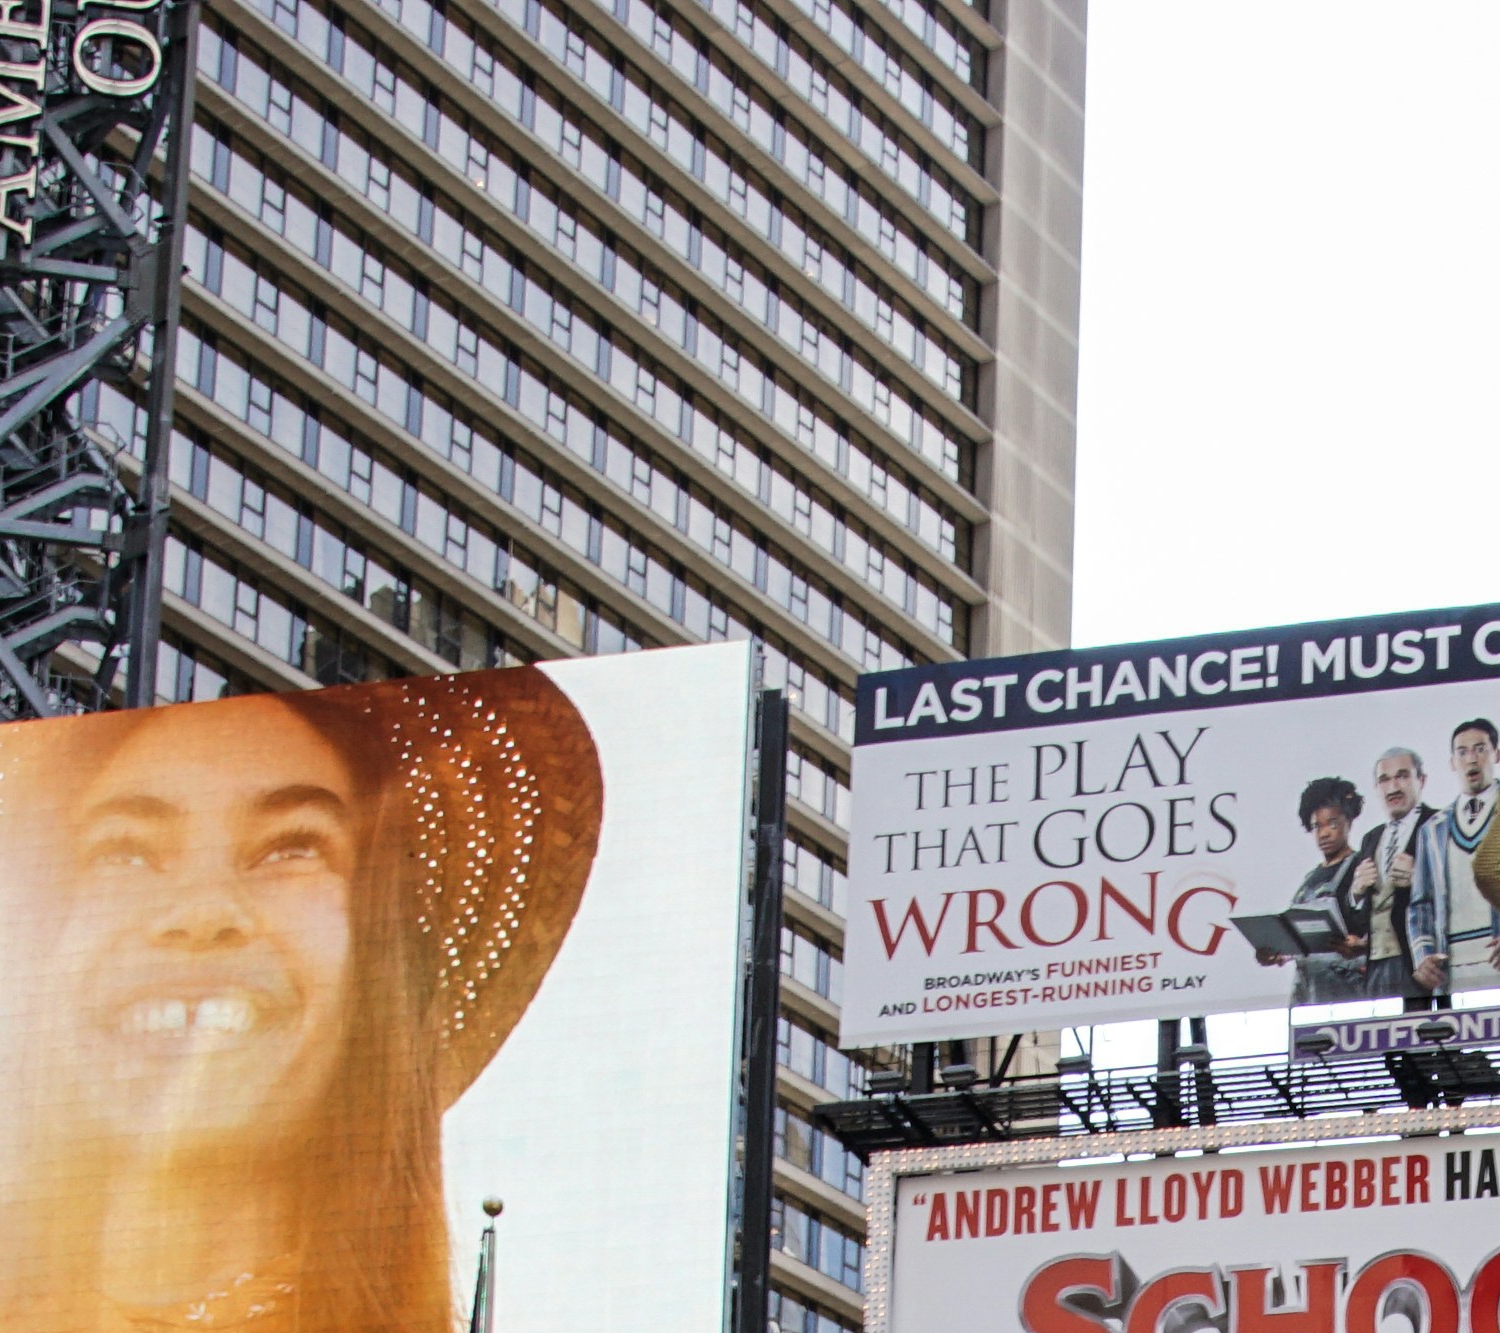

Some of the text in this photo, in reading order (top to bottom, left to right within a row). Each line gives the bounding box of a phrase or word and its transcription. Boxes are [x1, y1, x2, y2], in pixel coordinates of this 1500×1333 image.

[873, 674, 1018, 731] LAST
[1026, 645, 1280, 715] CHANCE!
[1301, 624, 1461, 685] MUST
[905, 726, 1211, 811] THE PLAY
[873, 792, 1238, 875] THAT GOES
[867, 871, 1238, 962] WRONG
[878, 974, 1207, 1018] AND LONGEST-RUNNING PLAY
[1046, 952, 1162, 980] FUNNIEST
[1115, 1165, 1247, 1228] LLOYD
[1261, 1154, 1432, 1219] WEBBER
